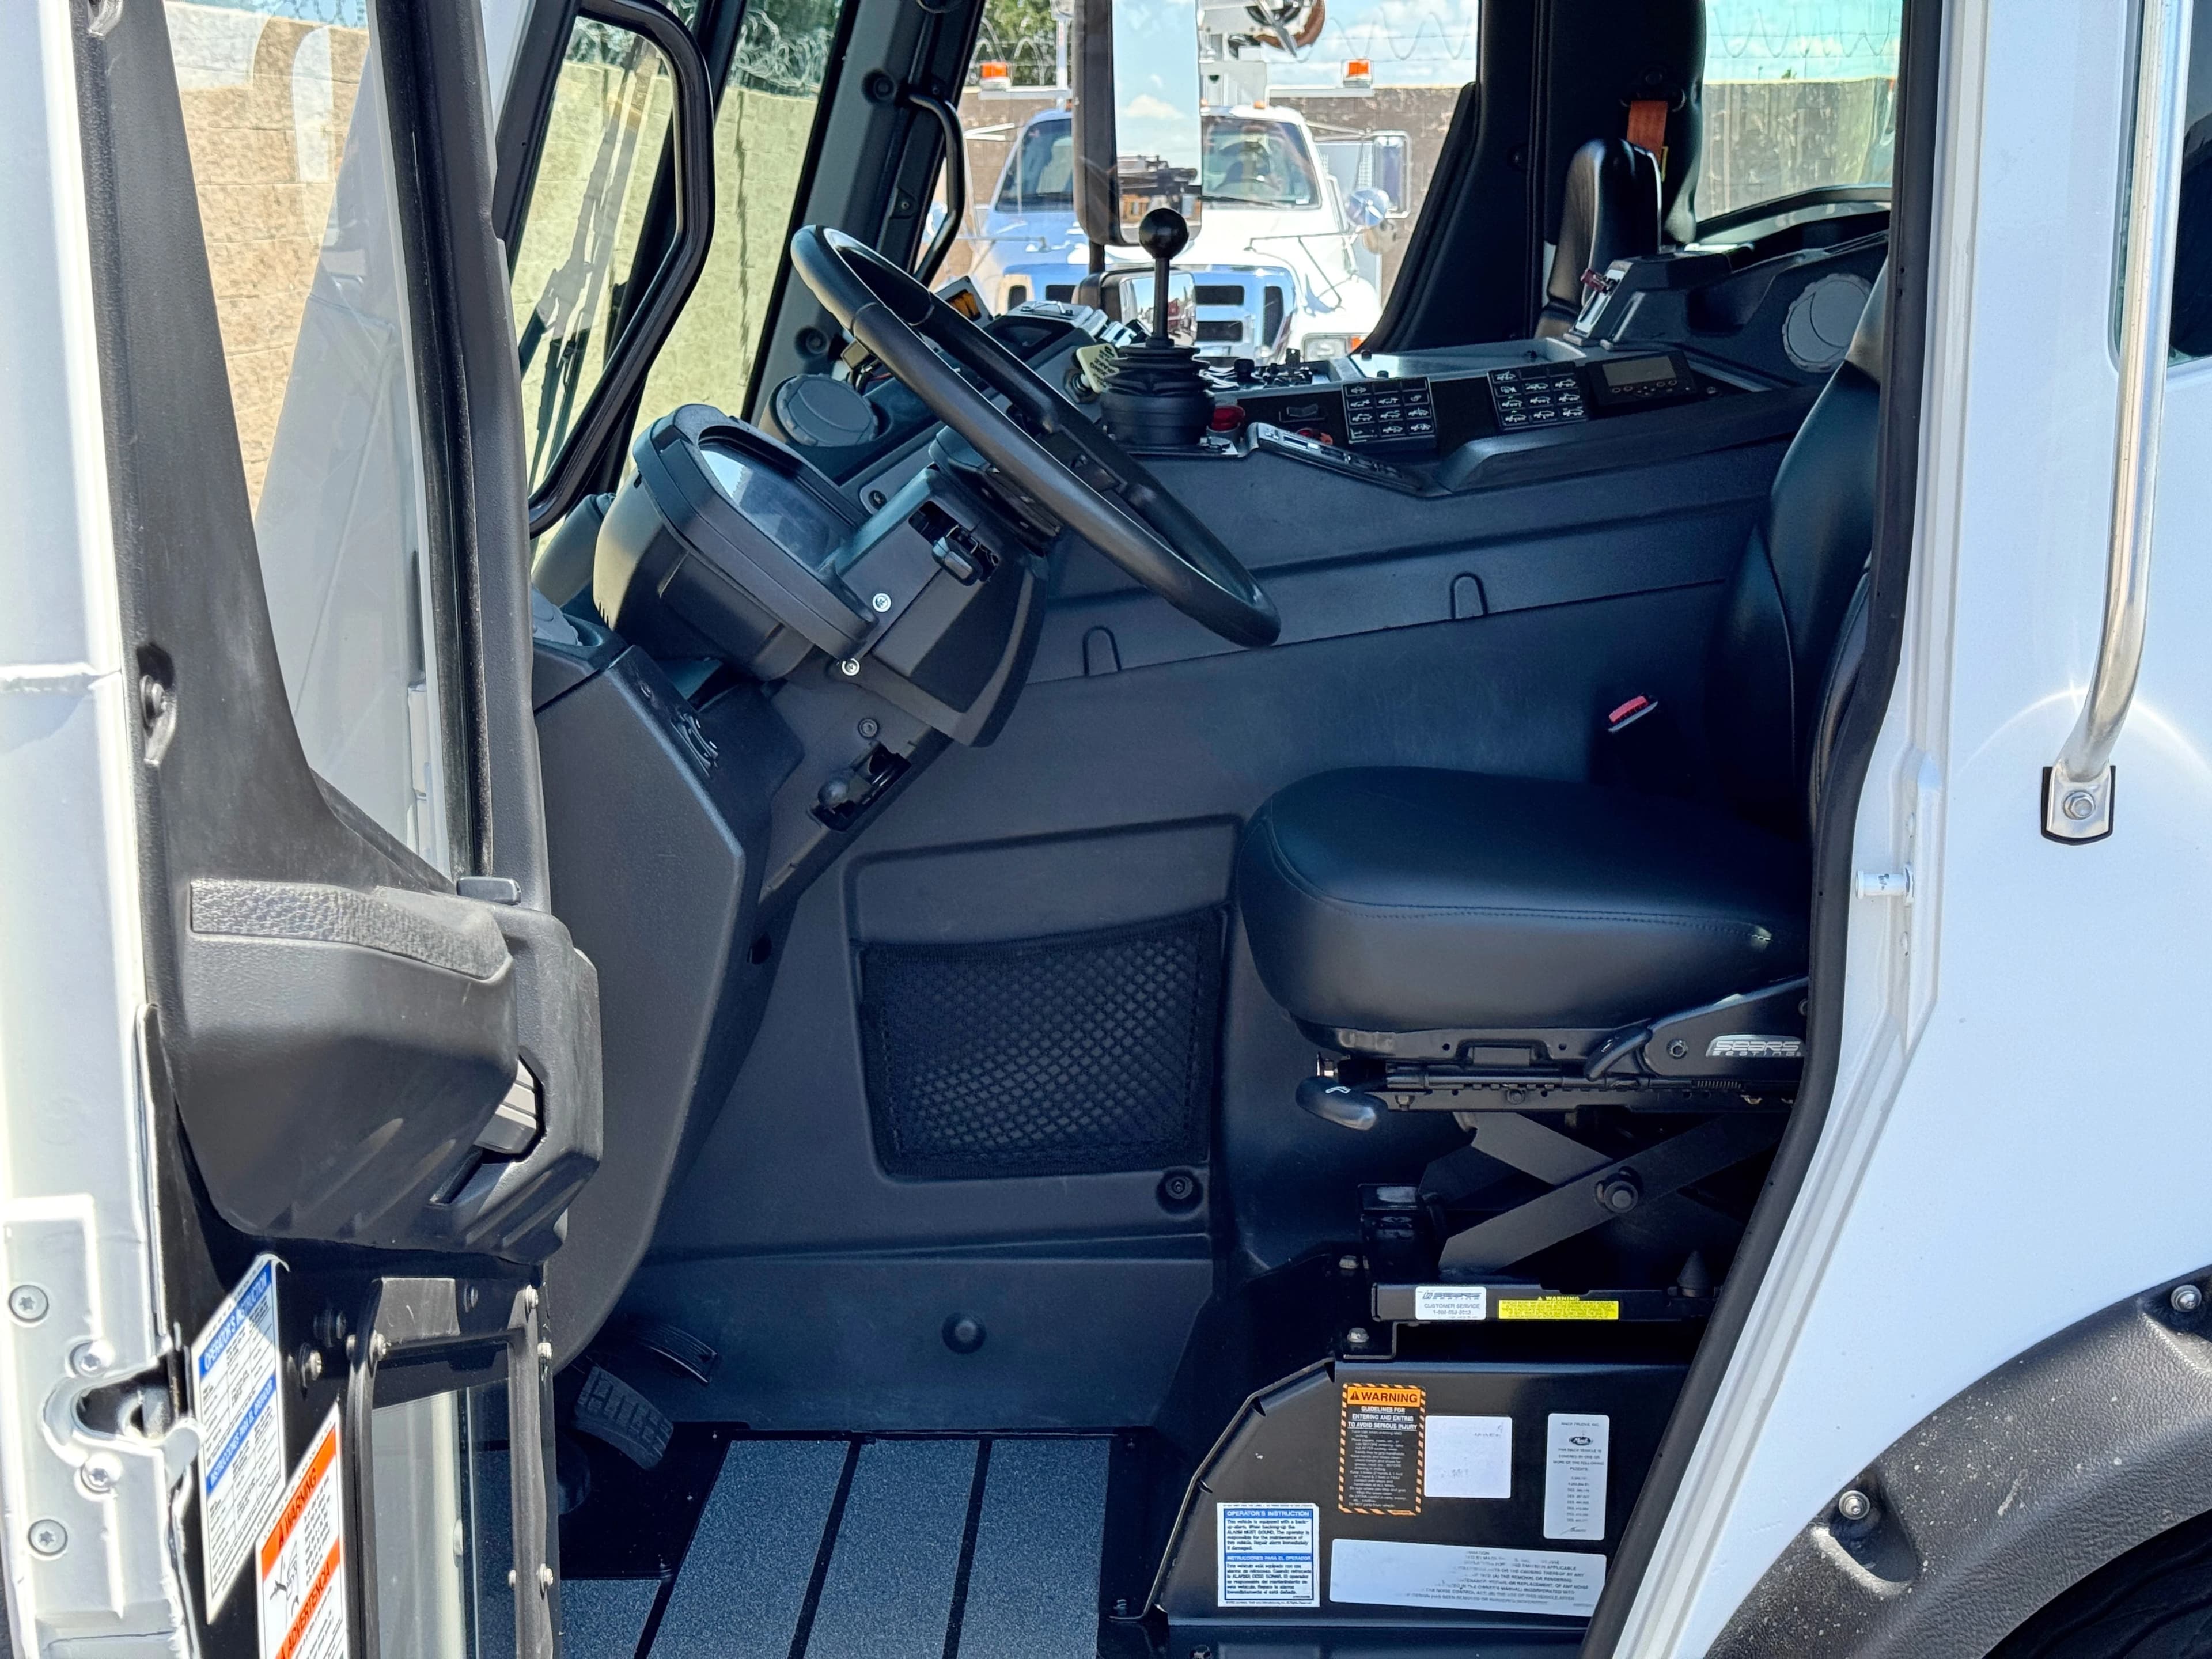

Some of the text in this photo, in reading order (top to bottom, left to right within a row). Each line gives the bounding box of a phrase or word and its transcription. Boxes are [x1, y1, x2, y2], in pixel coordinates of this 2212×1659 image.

[1361, 1391, 1418, 1403] WARNING
[285, 1468, 316, 1531] WARNING
[288, 1560, 330, 1645] ADVERTENCIA
